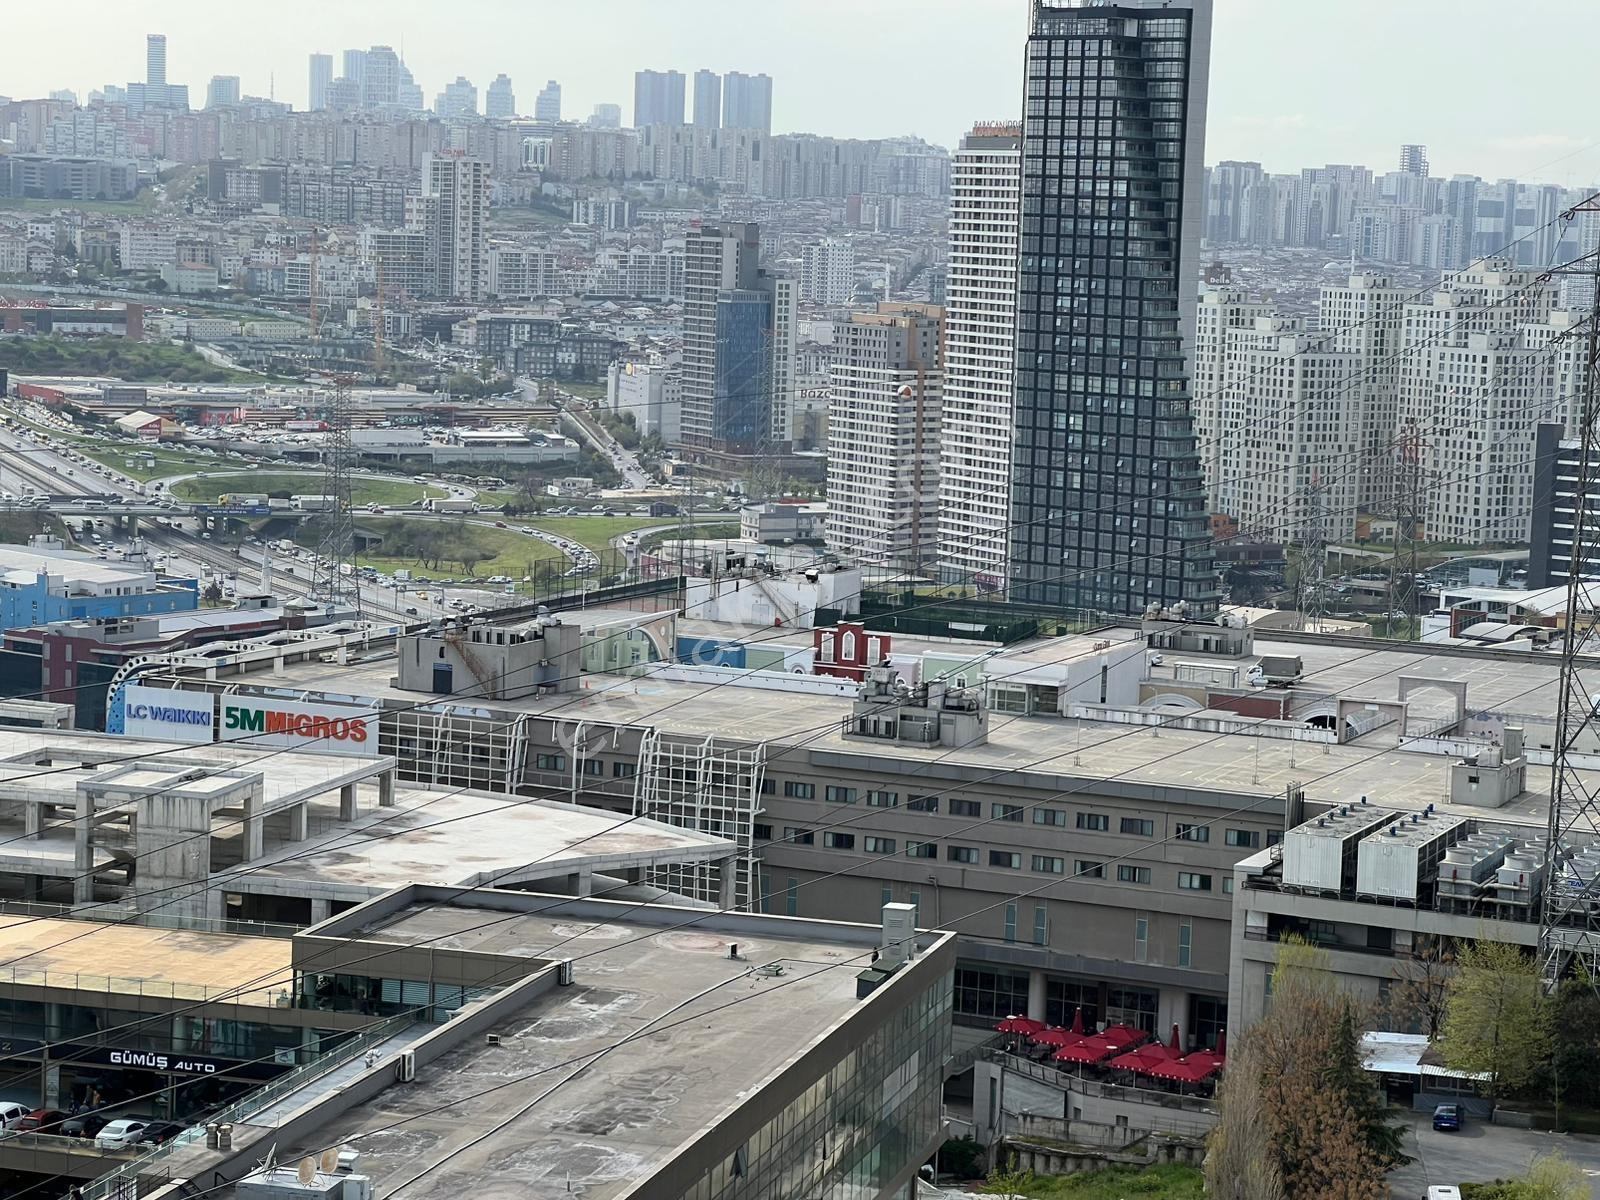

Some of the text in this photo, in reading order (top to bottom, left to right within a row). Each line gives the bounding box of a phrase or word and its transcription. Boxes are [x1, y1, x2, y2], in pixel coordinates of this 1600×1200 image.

[126, 704, 148, 720] LC
[110, 1050, 215, 1073] GÜMÜŞ AUTO
